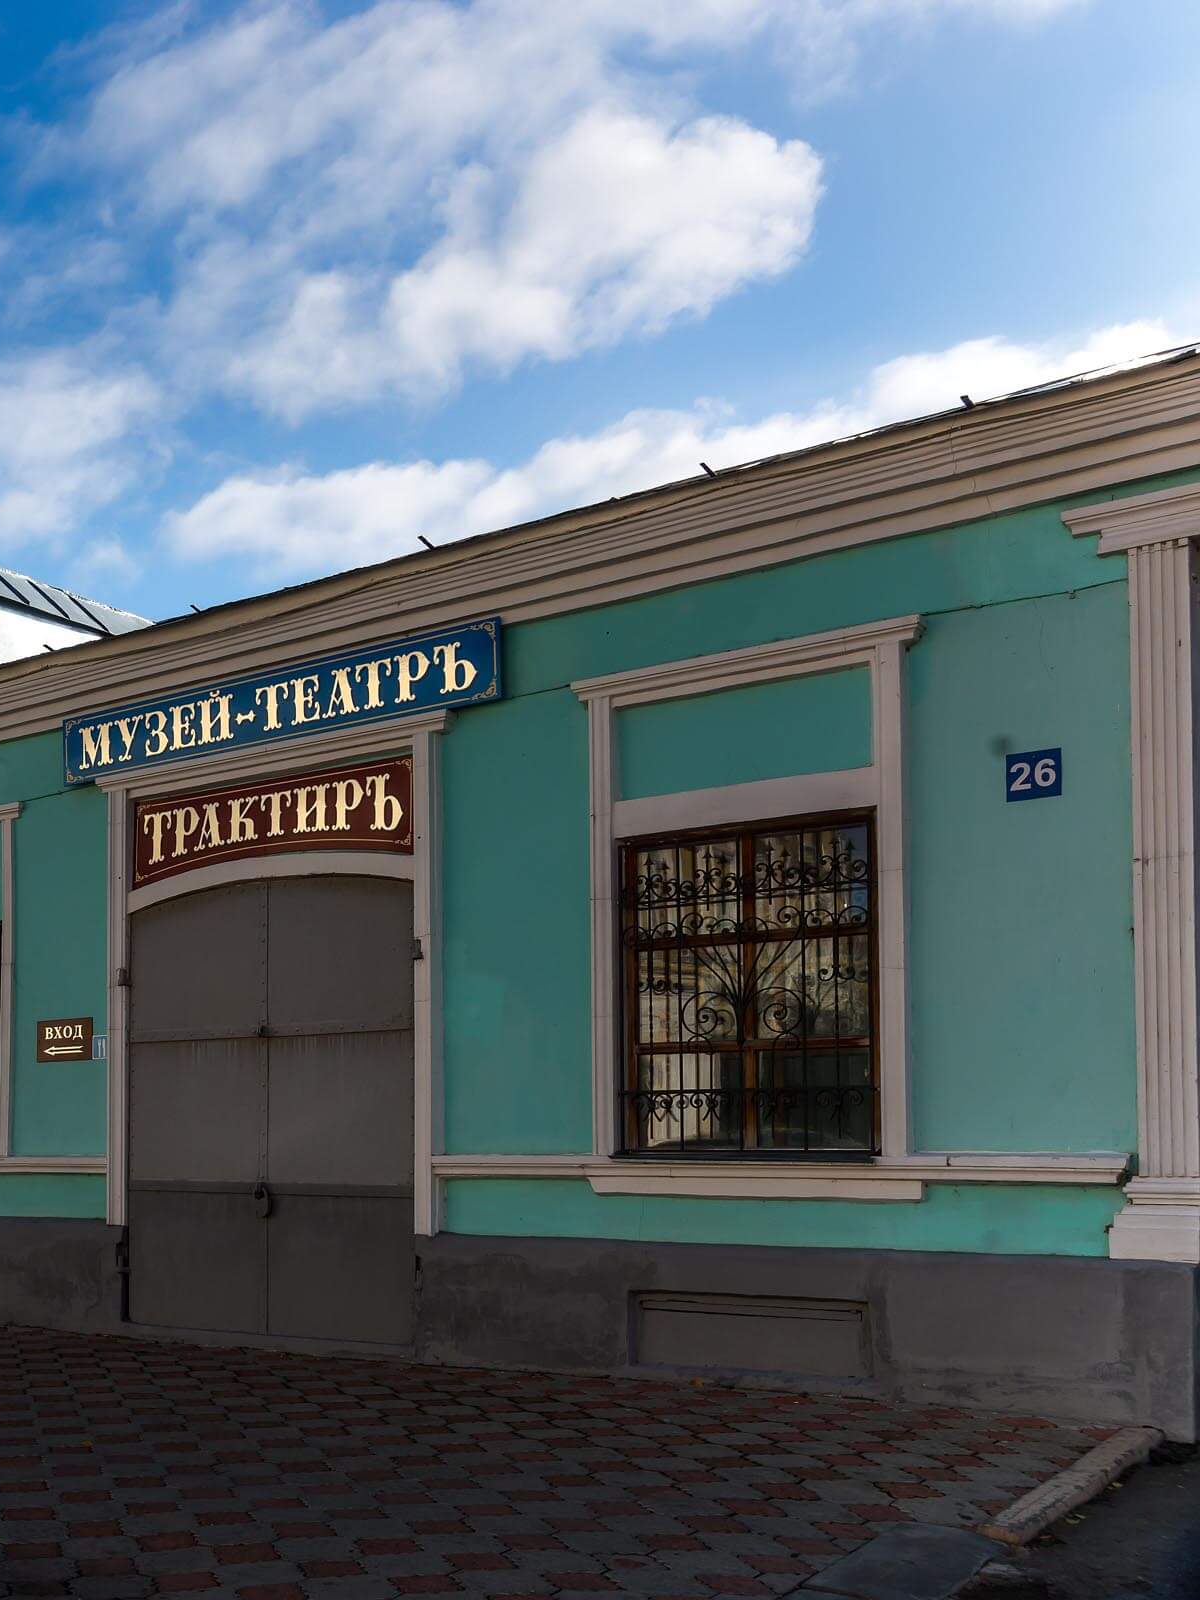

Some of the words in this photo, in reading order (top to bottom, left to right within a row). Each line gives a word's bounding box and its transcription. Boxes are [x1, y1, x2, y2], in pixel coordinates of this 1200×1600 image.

[78, 641, 478, 770] МУЗЕЙ-ТЕАТРЪ
[1010, 758, 1056, 792] 26
[143, 773, 404, 865] ТРАКТИРЪ
[45, 1024, 83, 1040] ВХОД
